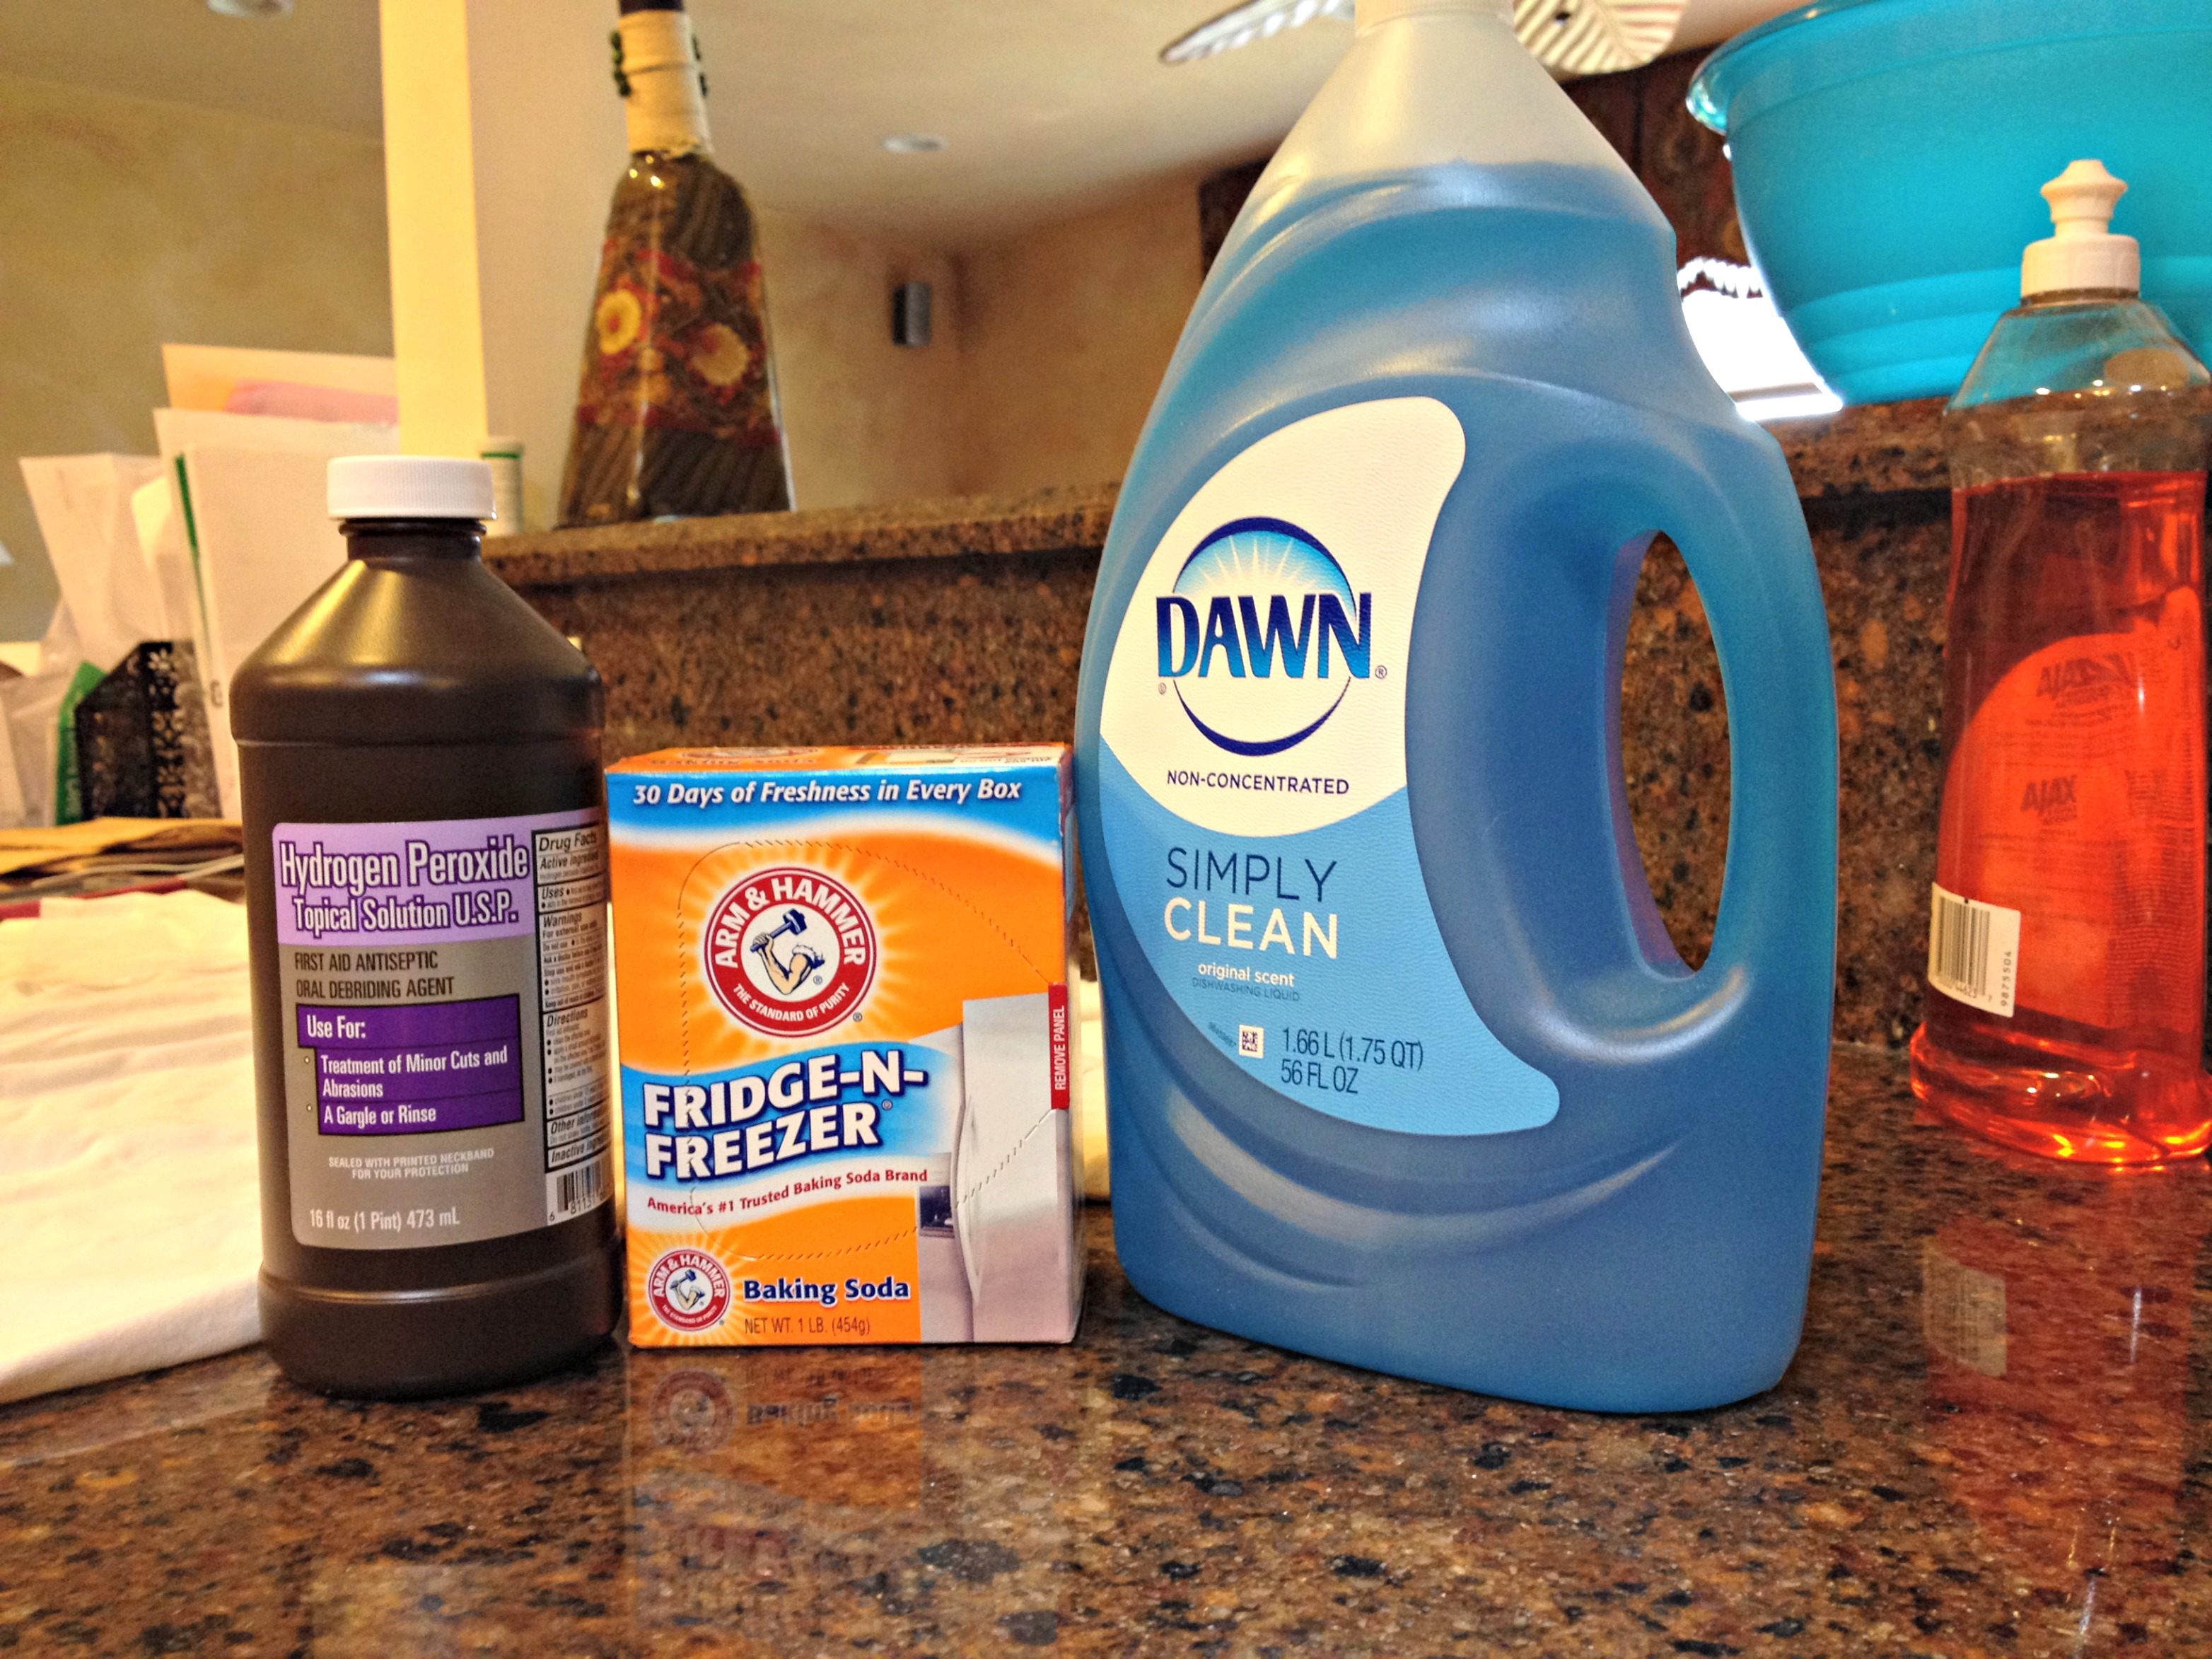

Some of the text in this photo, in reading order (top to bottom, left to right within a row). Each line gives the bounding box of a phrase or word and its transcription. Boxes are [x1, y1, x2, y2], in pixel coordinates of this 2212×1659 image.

[1156, 593, 1372, 679] DAWN
[634, 778, 1023, 808] 30 Days of Freshness in Every Box
[1167, 769, 1349, 795] NON-CONCENTRATED
[539, 832, 598, 853] Drug Facts
[280, 834, 530, 897] Hydrogen Peroxide
[540, 854, 568, 870] Active
[1166, 846, 1337, 902] SIMPLY
[542, 887, 564, 900] Uses
[293, 897, 359, 938] Topical
[361, 894, 450, 931] Solution
[451, 890, 519, 926] U.S.P.
[542, 911, 582, 928] Warnings
[715, 876, 866, 969] ARM & HAMMER
[1164, 897, 1338, 960] CLEAN
[296, 951, 438, 971] FIRST AID ANTISEPTIC
[296, 977, 455, 999] ORAL DEBRIDING AGENT
[1198, 962, 1296, 988] original scent
[733, 982, 851, 1022] THE STANDARD OF PURITY
[1192, 977, 1301, 1002] DISHWASHING LIQUID
[307, 1015, 366, 1038] Use For:
[547, 1008, 588, 1027] Directions
[321, 1045, 508, 1074] Treatment of Minor Cuts and
[1053, 1005, 1066, 1090] REMOVE PANEL
[1281, 1027, 1424, 1072] 1.66 L (1.75 QT)
[322, 1080, 383, 1098] Abrasions
[643, 1049, 929, 1131] FRIDGE-N-
[1280, 1059, 1359, 1095] 56 FL OZ
[324, 1105, 437, 1129] A Gargle or Rinse
[551, 1117, 575, 1134] Other
[551, 1142, 585, 1163] Inactive
[644, 1101, 884, 1184] FREEZER
[328, 1148, 494, 1169] SEALED WITH PRINTED NECKBAND
[352, 1163, 470, 1180] FOR YOUR PROTECTION
[647, 1169, 928, 1216] America's #1 Trusted Baking Soda Brand
[310, 1206, 460, 1233] 16 fl oz (1 Pint) 473 mL
[653, 1266, 670, 1298] ARM
[680, 1254, 726, 1298] HAMMER
[743, 1276, 911, 1308] Baking Soda
[745, 1316, 871, 1337] NET WT. 1 LB. (454g)
